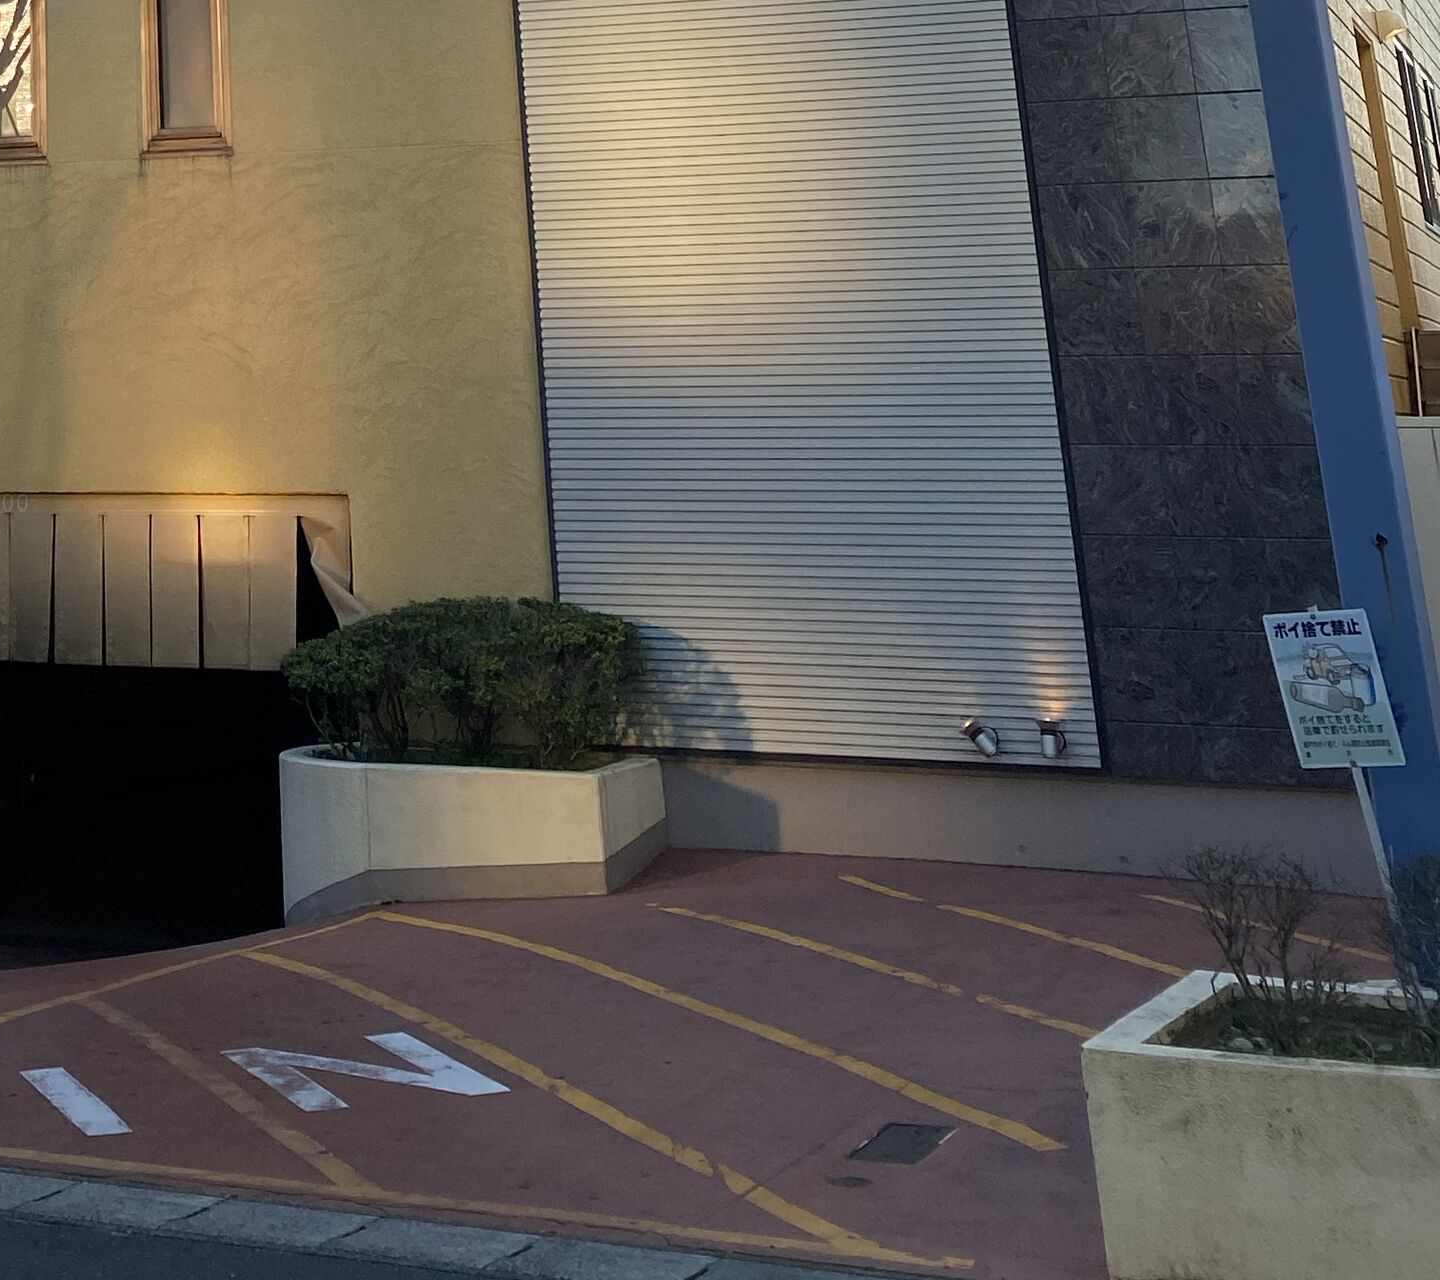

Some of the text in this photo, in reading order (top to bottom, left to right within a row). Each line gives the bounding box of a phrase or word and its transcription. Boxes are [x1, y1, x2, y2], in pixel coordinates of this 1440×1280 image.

[1273, 618, 1362, 639] ポイ捨て禁止
[20, 1031, 511, 1137] IN
